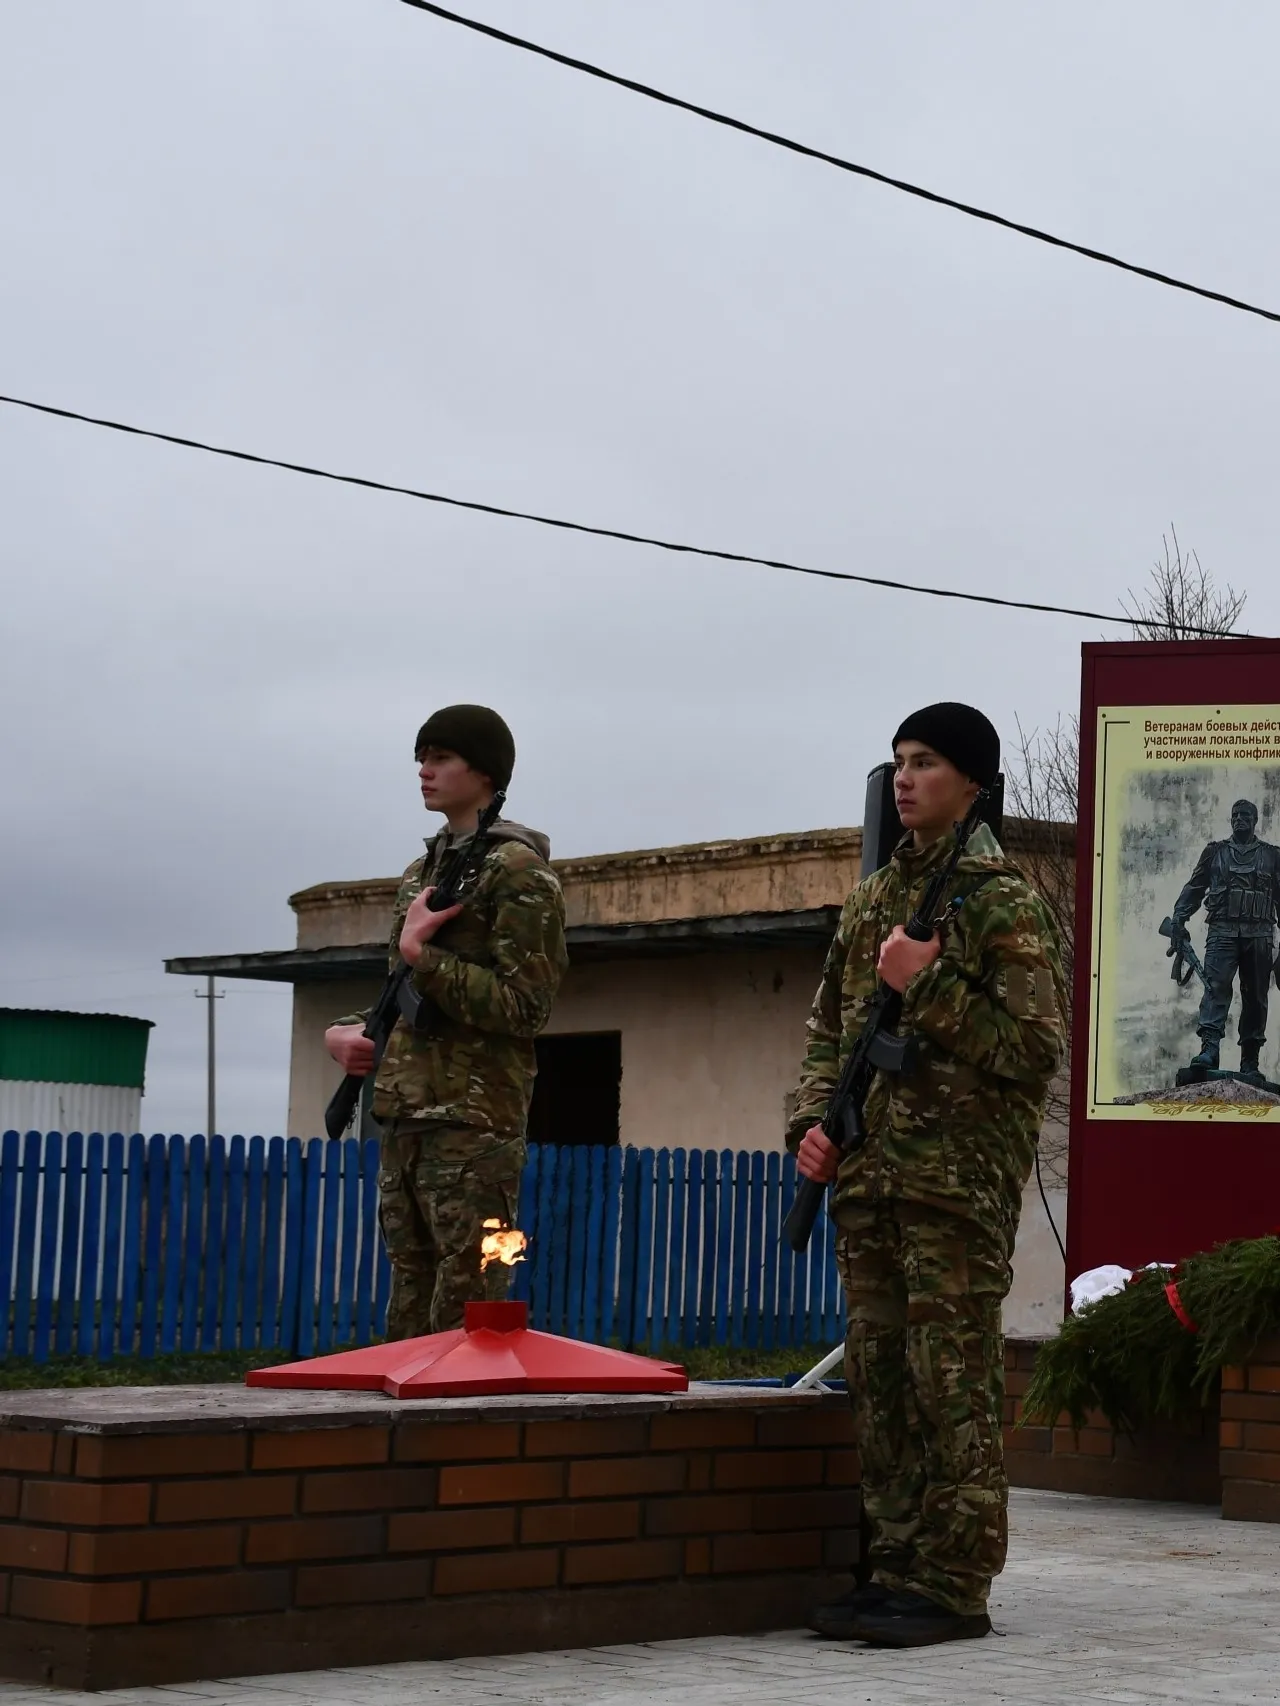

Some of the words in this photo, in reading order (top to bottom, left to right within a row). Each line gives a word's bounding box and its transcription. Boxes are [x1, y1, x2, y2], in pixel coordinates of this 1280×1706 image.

[1144, 720, 1203, 734] Ветеранам
[1206, 720, 1248, 732] боевых
[1143, 735, 1206, 748] участникам
[1210, 734, 1270, 746] локальных
[1146, 749, 1153, 759] и
[1156, 748, 1230, 762] вооруженных
